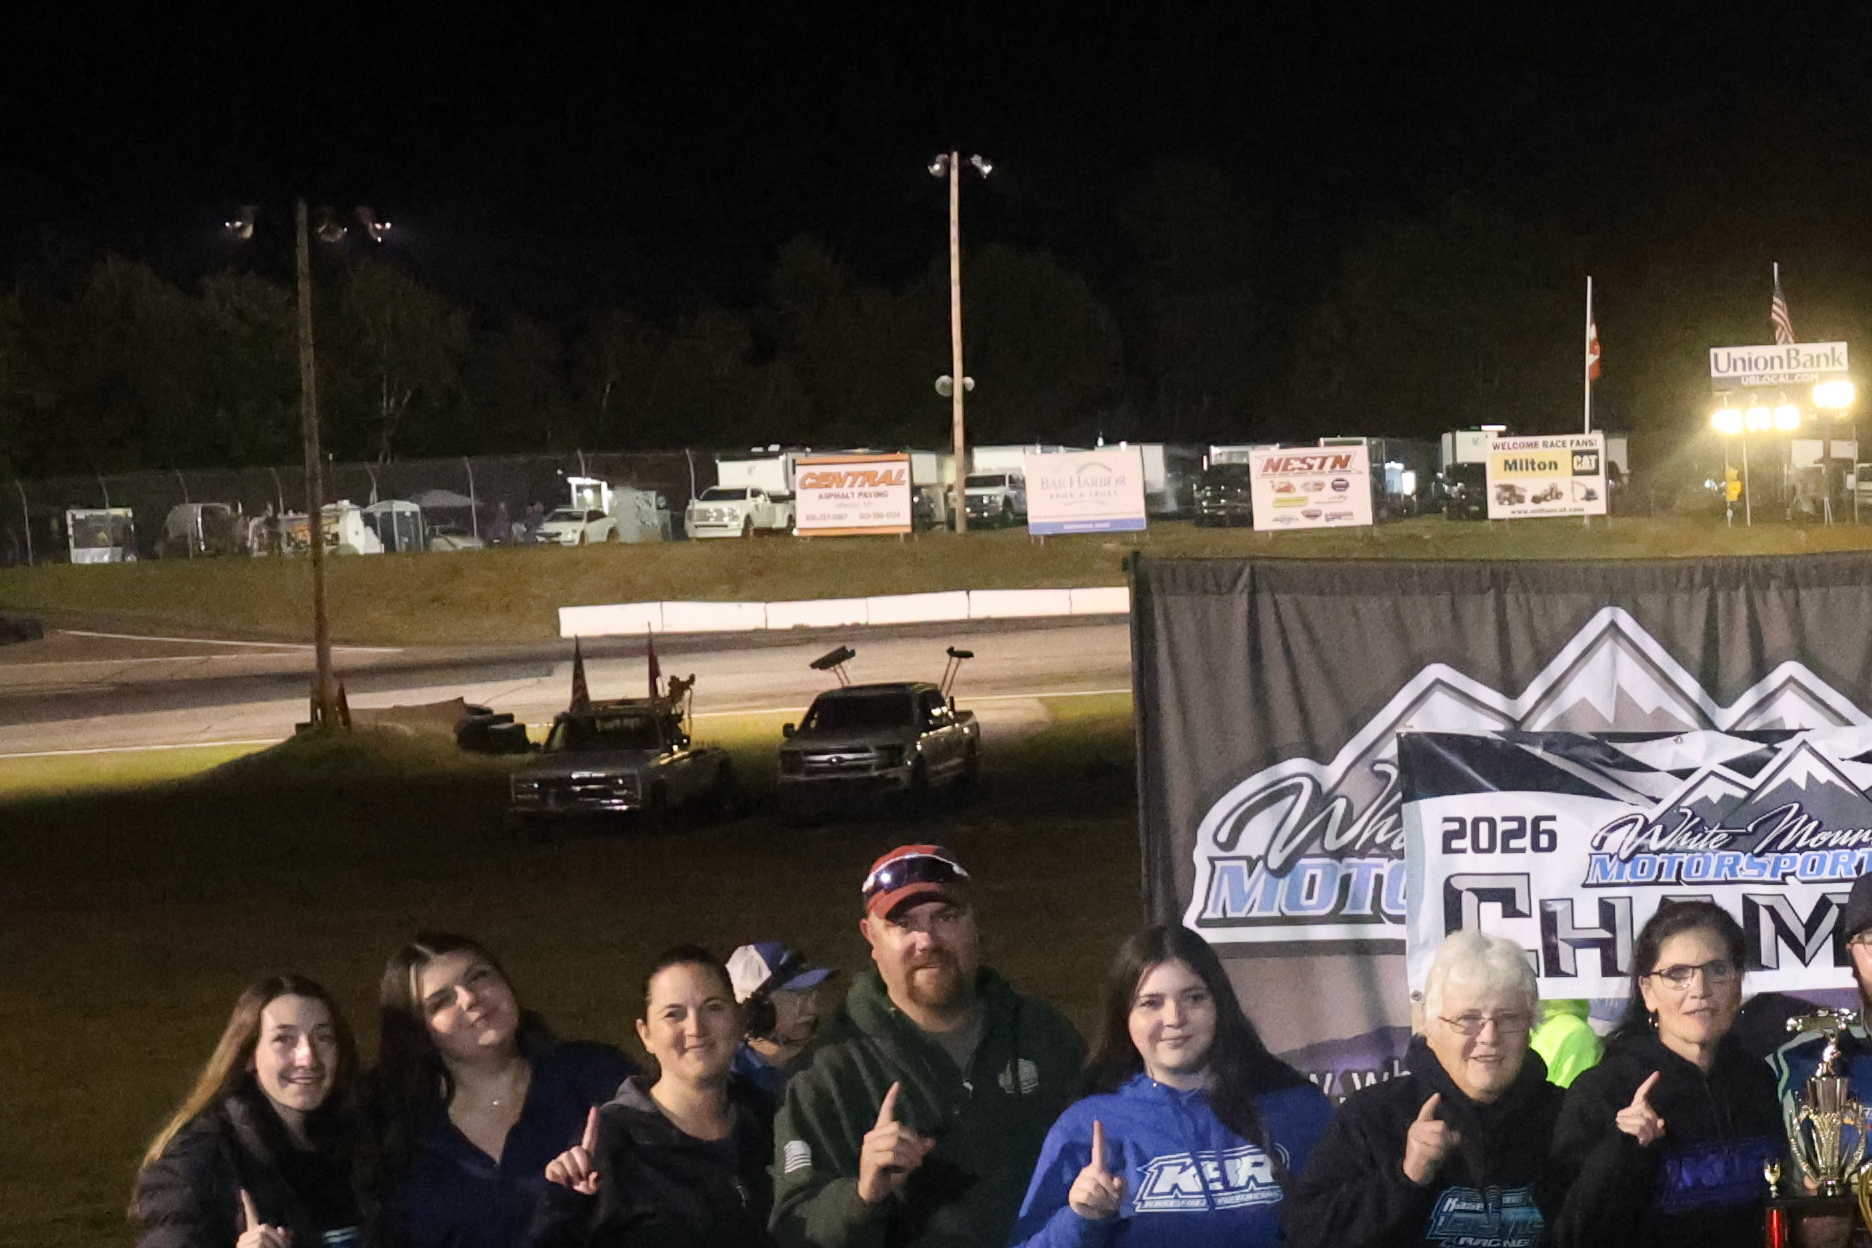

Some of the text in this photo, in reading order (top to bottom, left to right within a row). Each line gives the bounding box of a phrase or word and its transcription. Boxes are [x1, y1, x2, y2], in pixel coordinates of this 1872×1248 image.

[1492, 440, 1539, 450] WELCOME
[1542, 439, 1567, 449] RACE
[1503, 458, 1558, 472] Milton
[1573, 455, 1598, 471] CAT
[800, 469, 905, 490] CENTRAL
[818, 490, 855, 500] ASPHALT
[1441, 815, 1558, 855] 2026
[1590, 805, 1747, 863] White
